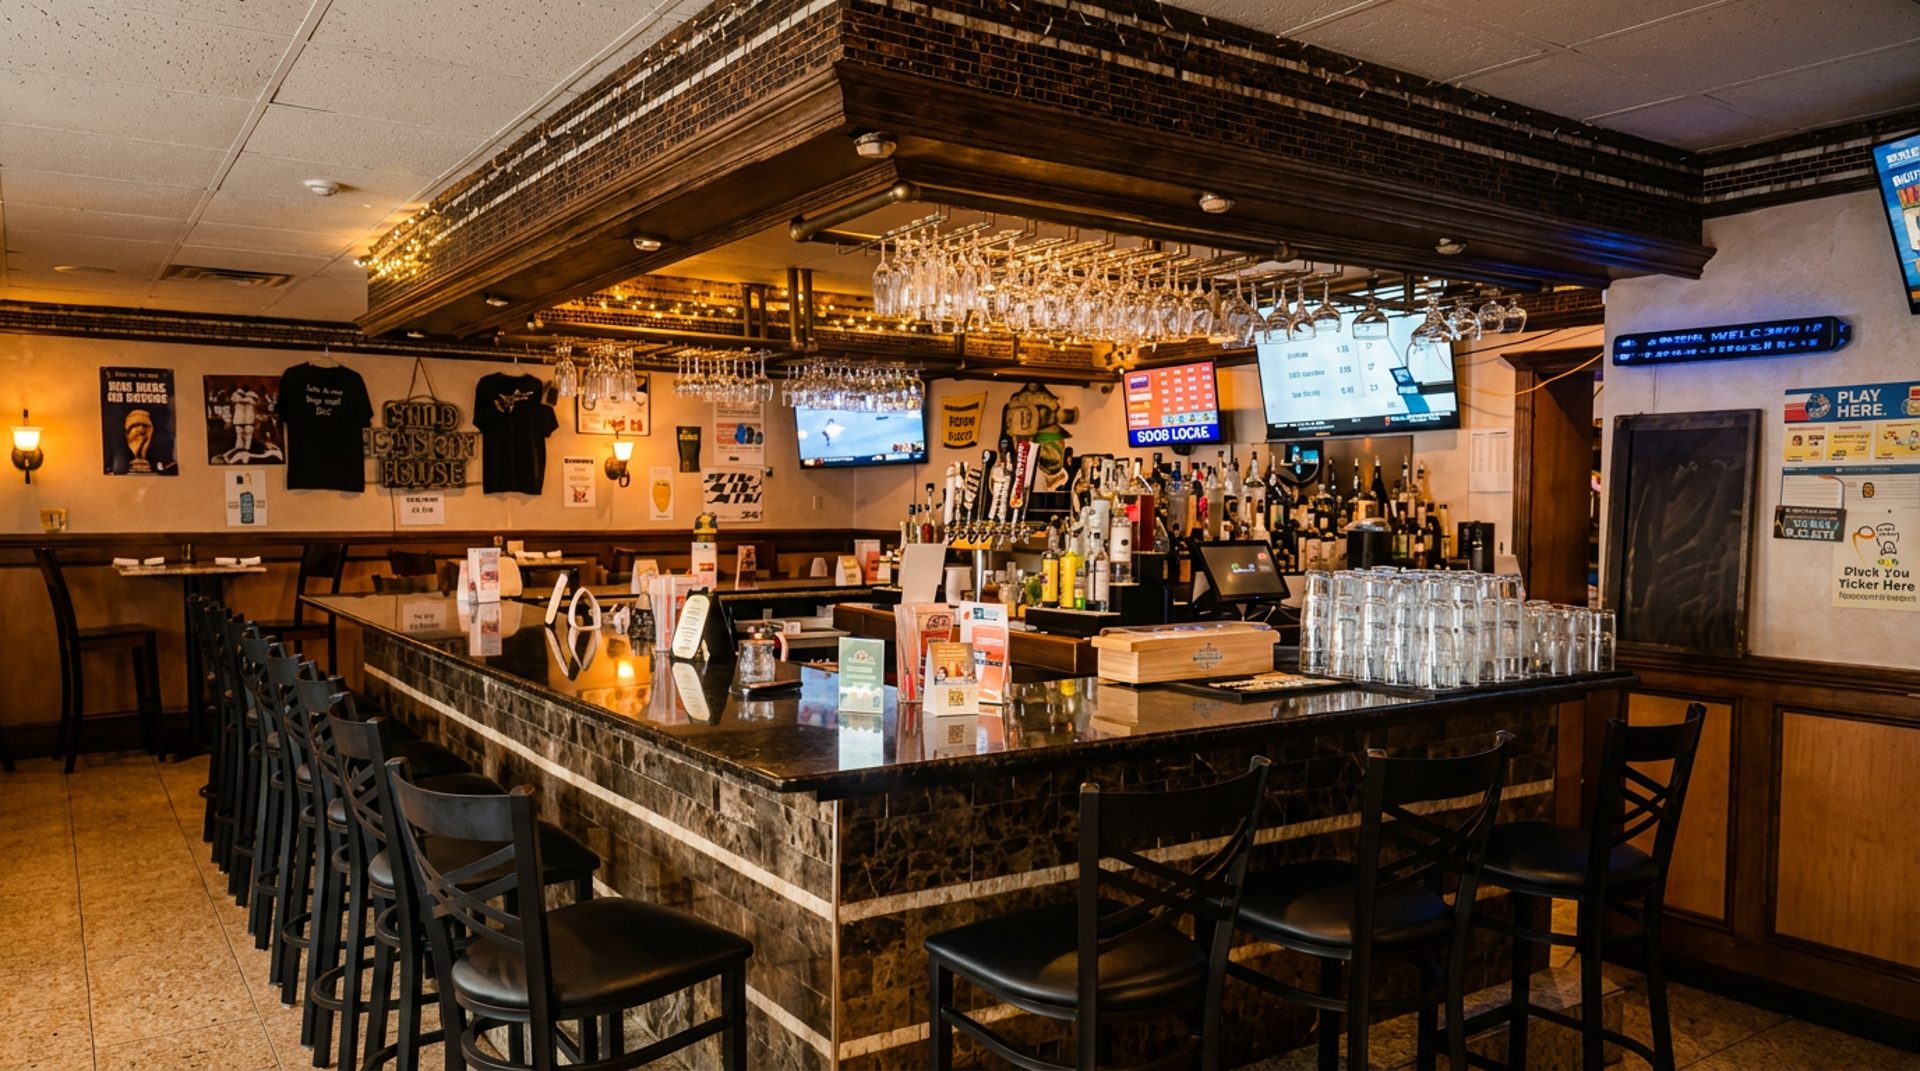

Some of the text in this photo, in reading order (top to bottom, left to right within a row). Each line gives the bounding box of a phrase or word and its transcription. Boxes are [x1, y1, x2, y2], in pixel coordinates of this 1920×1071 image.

[1837, 388, 1881, 404] PLAY
[1837, 403, 1887, 418] HERE.
[1884, 568, 1910, 579] You
[1883, 580, 1916, 592] Here
